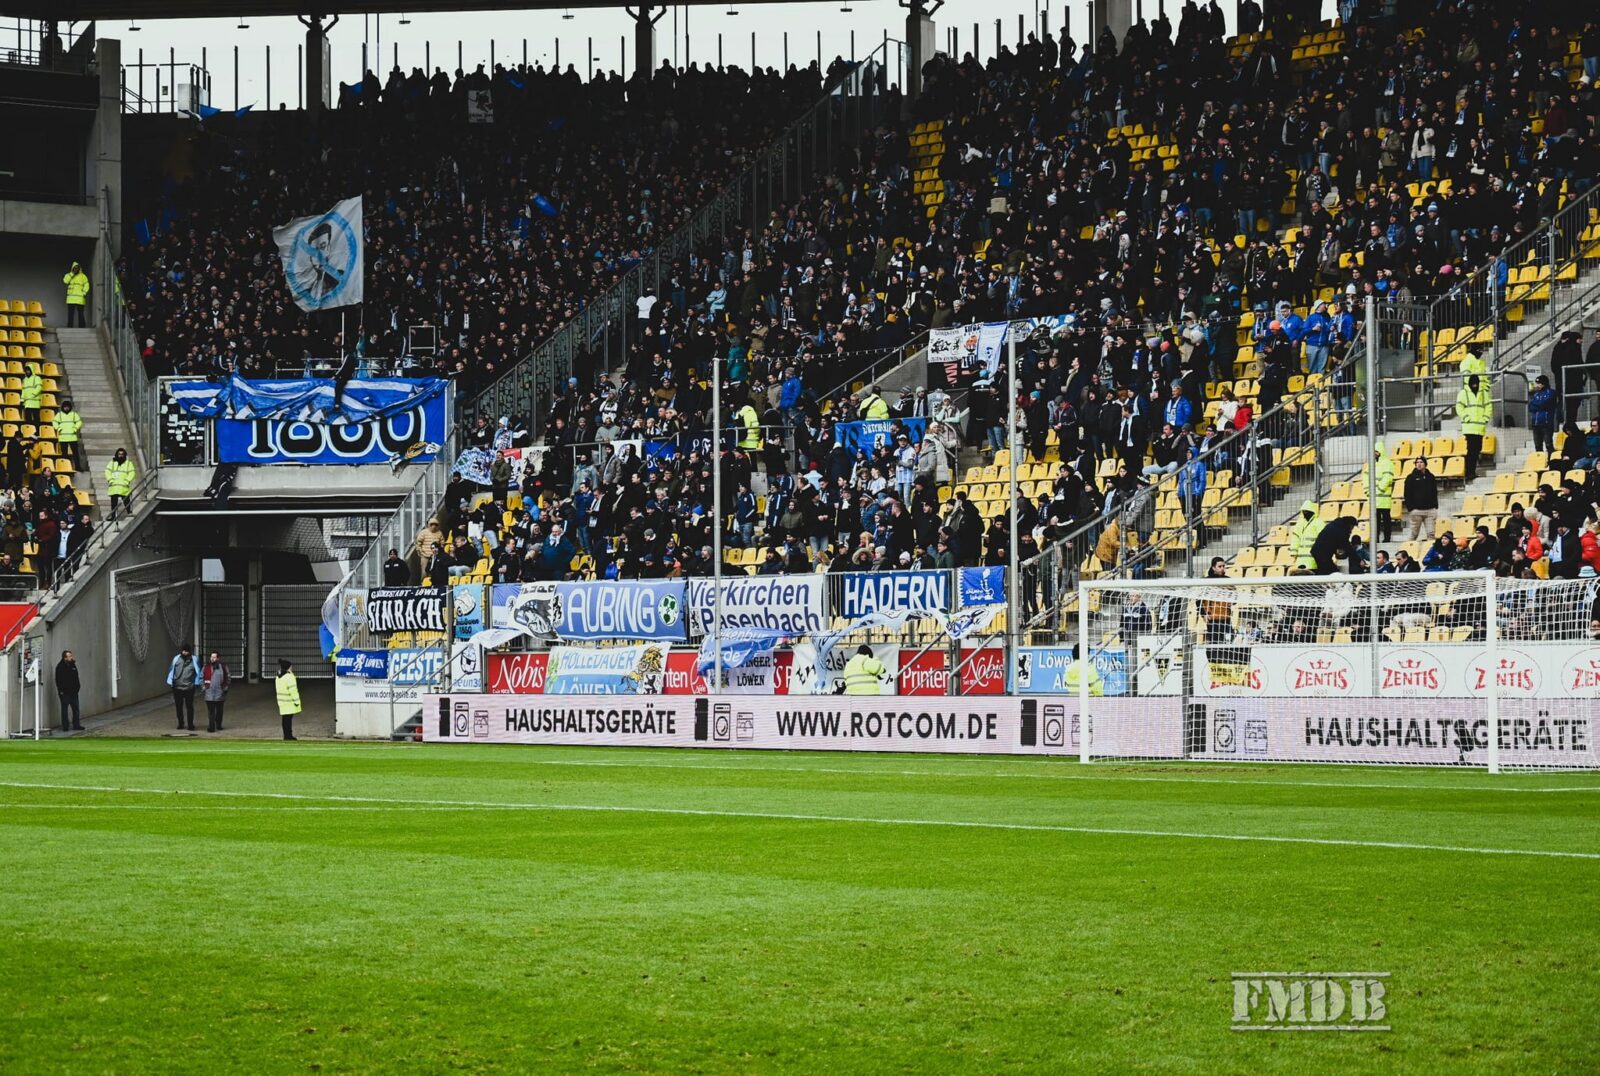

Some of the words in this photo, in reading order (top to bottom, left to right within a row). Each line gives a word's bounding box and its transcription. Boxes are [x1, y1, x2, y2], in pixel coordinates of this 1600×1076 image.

[690, 576, 809, 606] Vierkirchen
[845, 575, 945, 614] HADERN
[368, 597, 444, 632] SIMBACH
[567, 586, 655, 633] AUBING
[492, 654, 544, 693] Nobis
[902, 664, 950, 689] Printen
[1295, 667, 1348, 690] ZENTIS
[1382, 666, 1439, 690] ZENTIS
[1474, 667, 1534, 691] ZNTIS
[505, 703, 676, 735] HAUSHALTSGERÄTE
[776, 710, 998, 740] WWW.ROTCOM.DE
